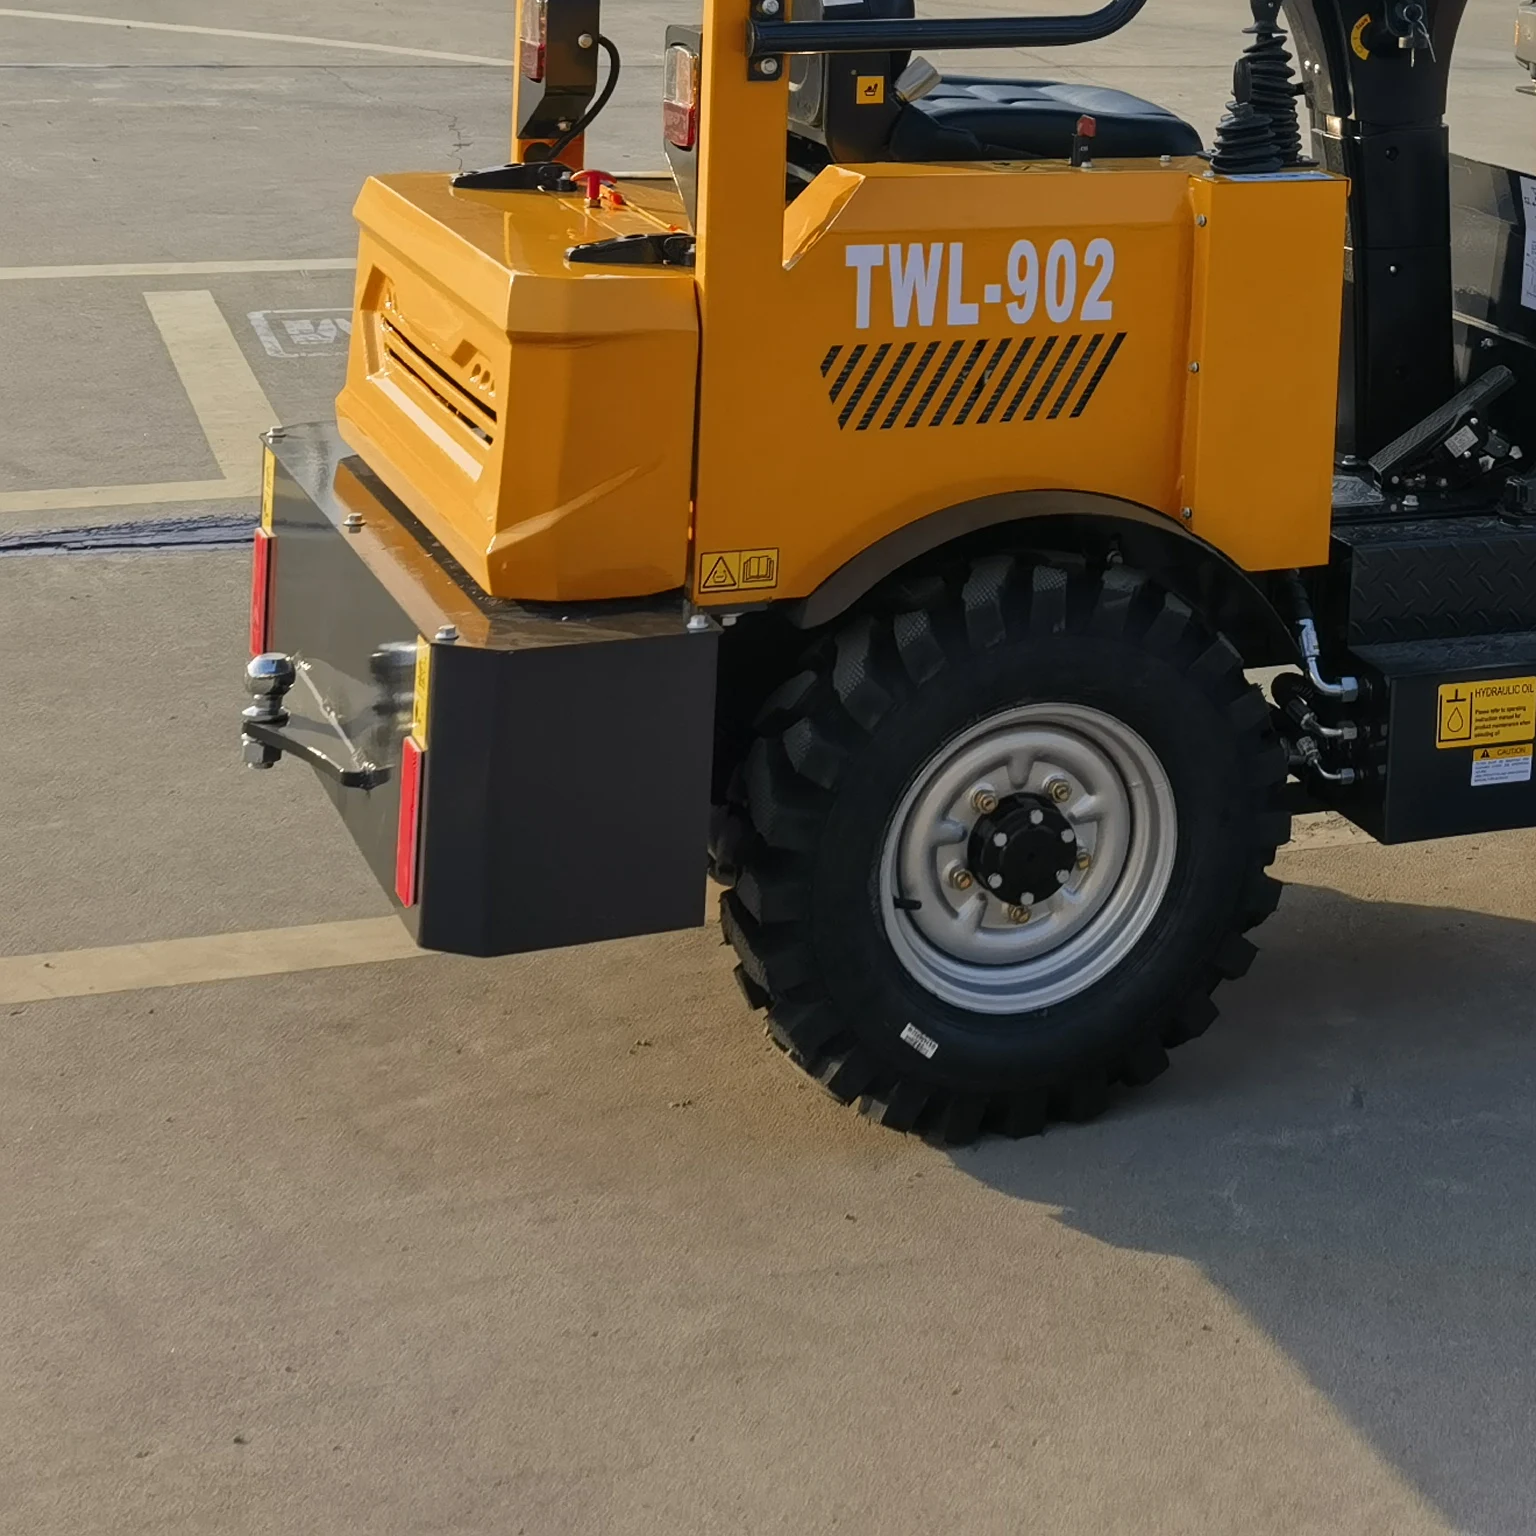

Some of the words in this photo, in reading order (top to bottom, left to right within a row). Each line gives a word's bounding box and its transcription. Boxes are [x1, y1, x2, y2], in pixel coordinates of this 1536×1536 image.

[845, 238, 1115, 329] TWL-902
[1475, 685, 1520, 698] HYDRAULIC
[1522, 684, 1534, 693] OIL
[1497, 747, 1526, 756] CAUTION
